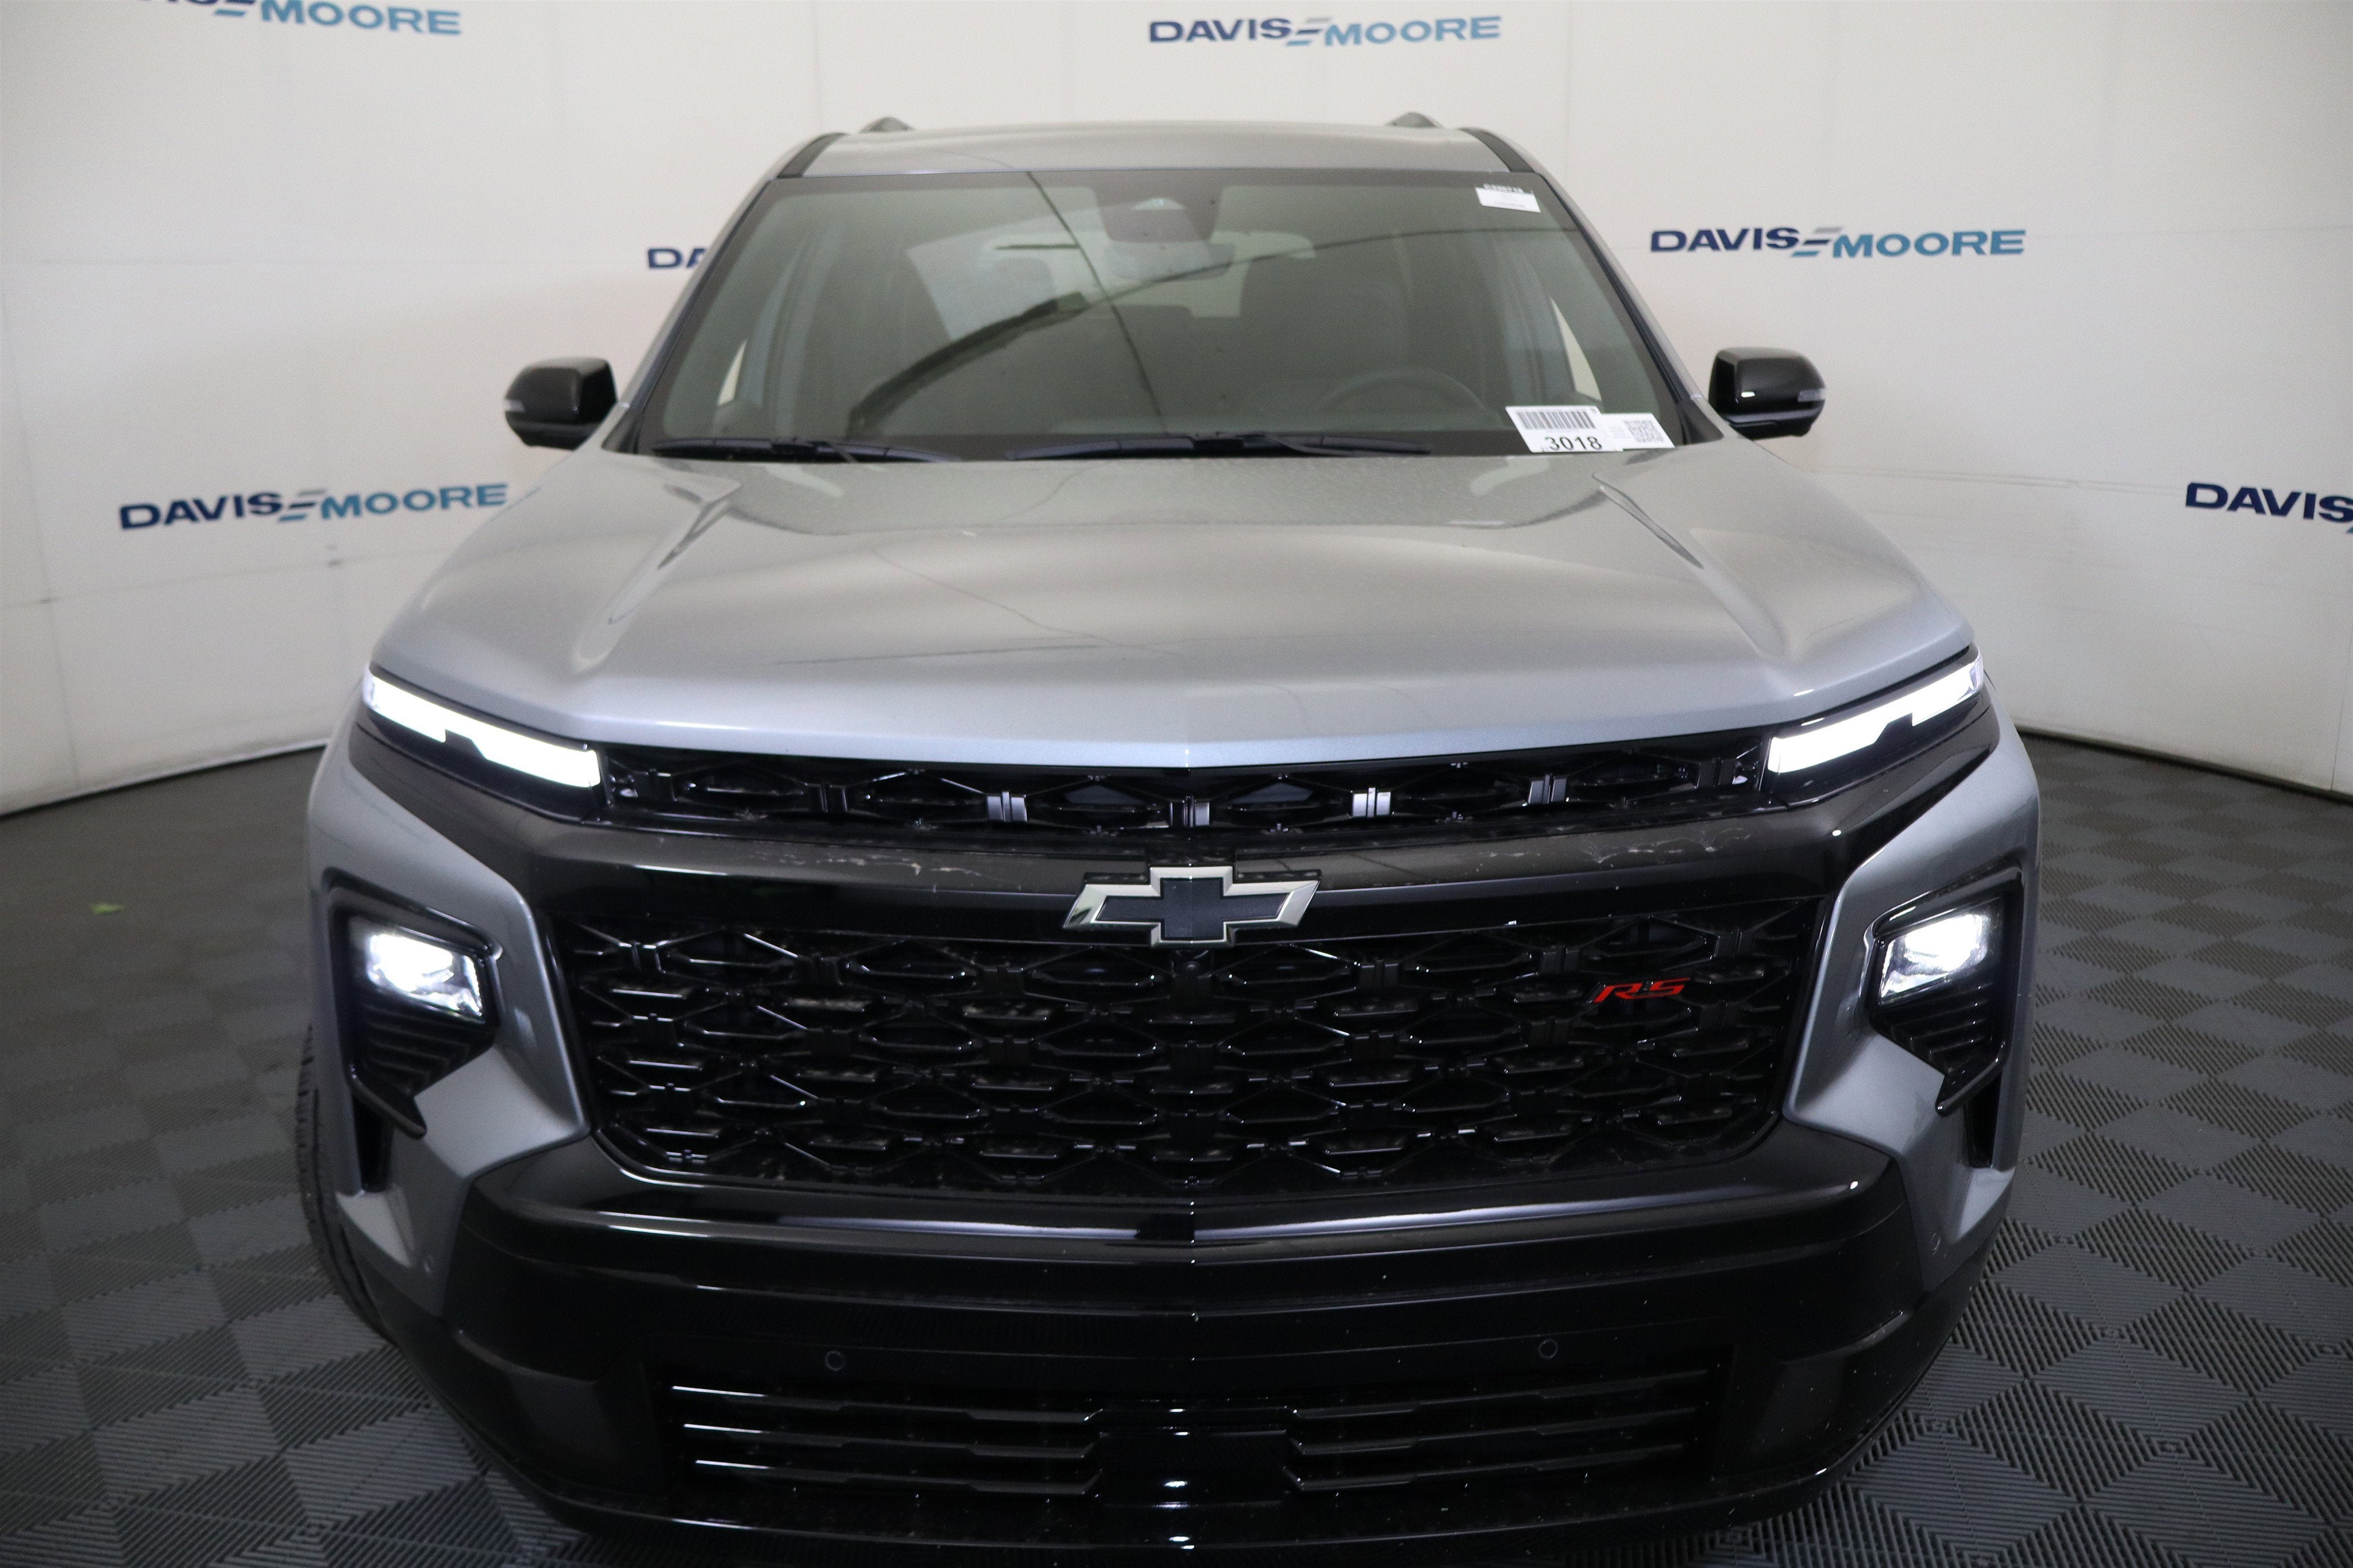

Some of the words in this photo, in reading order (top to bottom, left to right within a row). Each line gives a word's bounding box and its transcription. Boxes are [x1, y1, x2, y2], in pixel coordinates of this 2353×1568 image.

[261, 0, 462, 35] MOORE
[1149, 17, 1292, 43] DAVIS
[1324, 16, 1502, 47] MOORE
[1650, 226, 1800, 253] DAVIS
[1833, 229, 2027, 258] MOORE
[1545, 437, 1602, 450] 3018
[118, 492, 284, 530] DAVIS
[320, 483, 508, 520] MOORE
[2185, 482, 2353, 523] DAVIS
[1594, 978, 1690, 1003] RS
